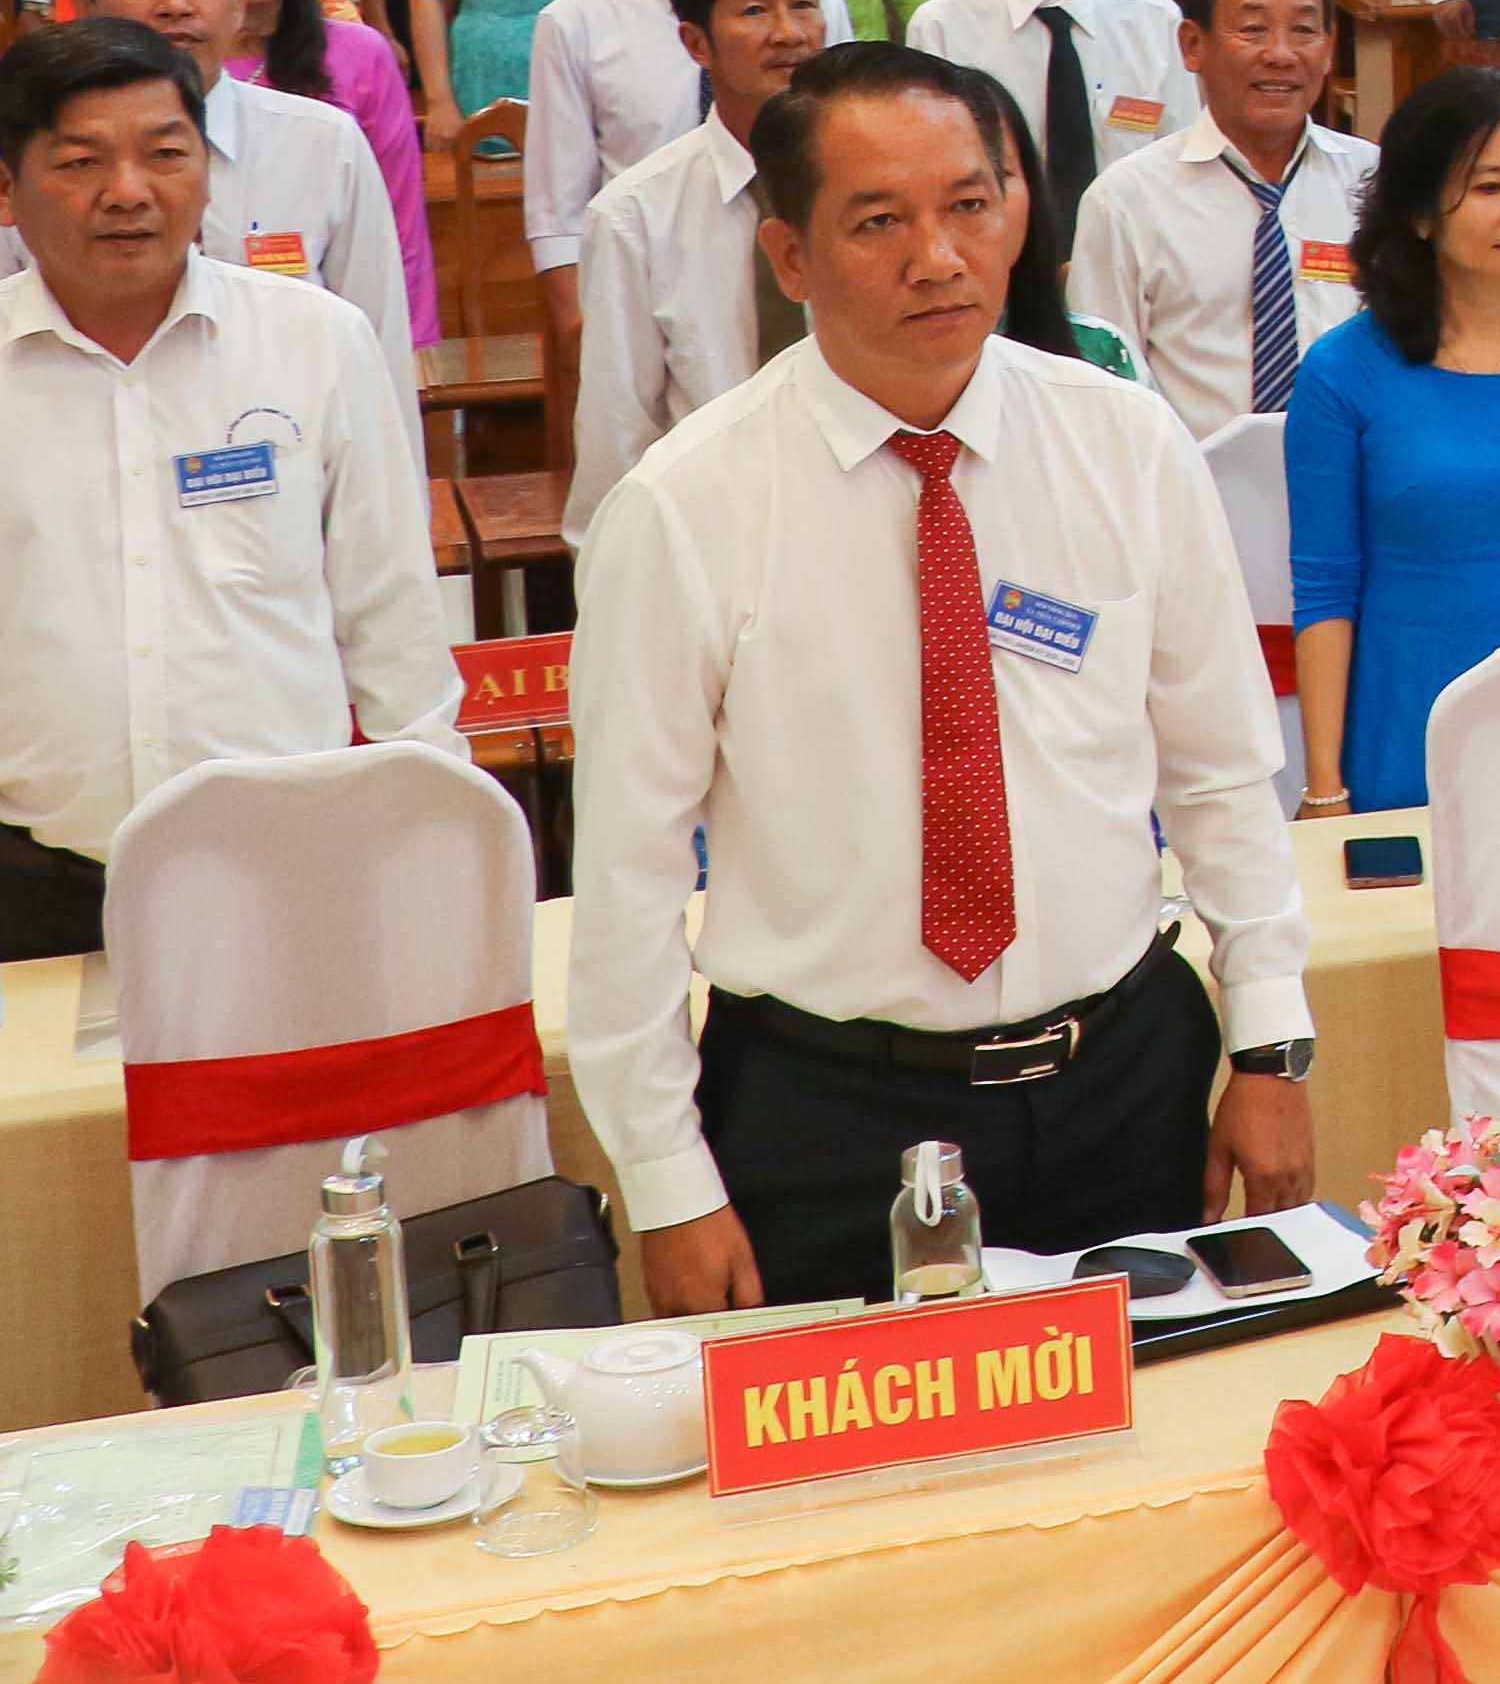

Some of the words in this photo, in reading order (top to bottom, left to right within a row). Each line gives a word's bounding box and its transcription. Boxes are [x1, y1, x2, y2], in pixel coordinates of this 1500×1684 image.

[472, 667, 527, 705] ẠI
[743, 1358, 957, 1448] KHÁCH
[975, 1325, 1094, 1412] MỜI
